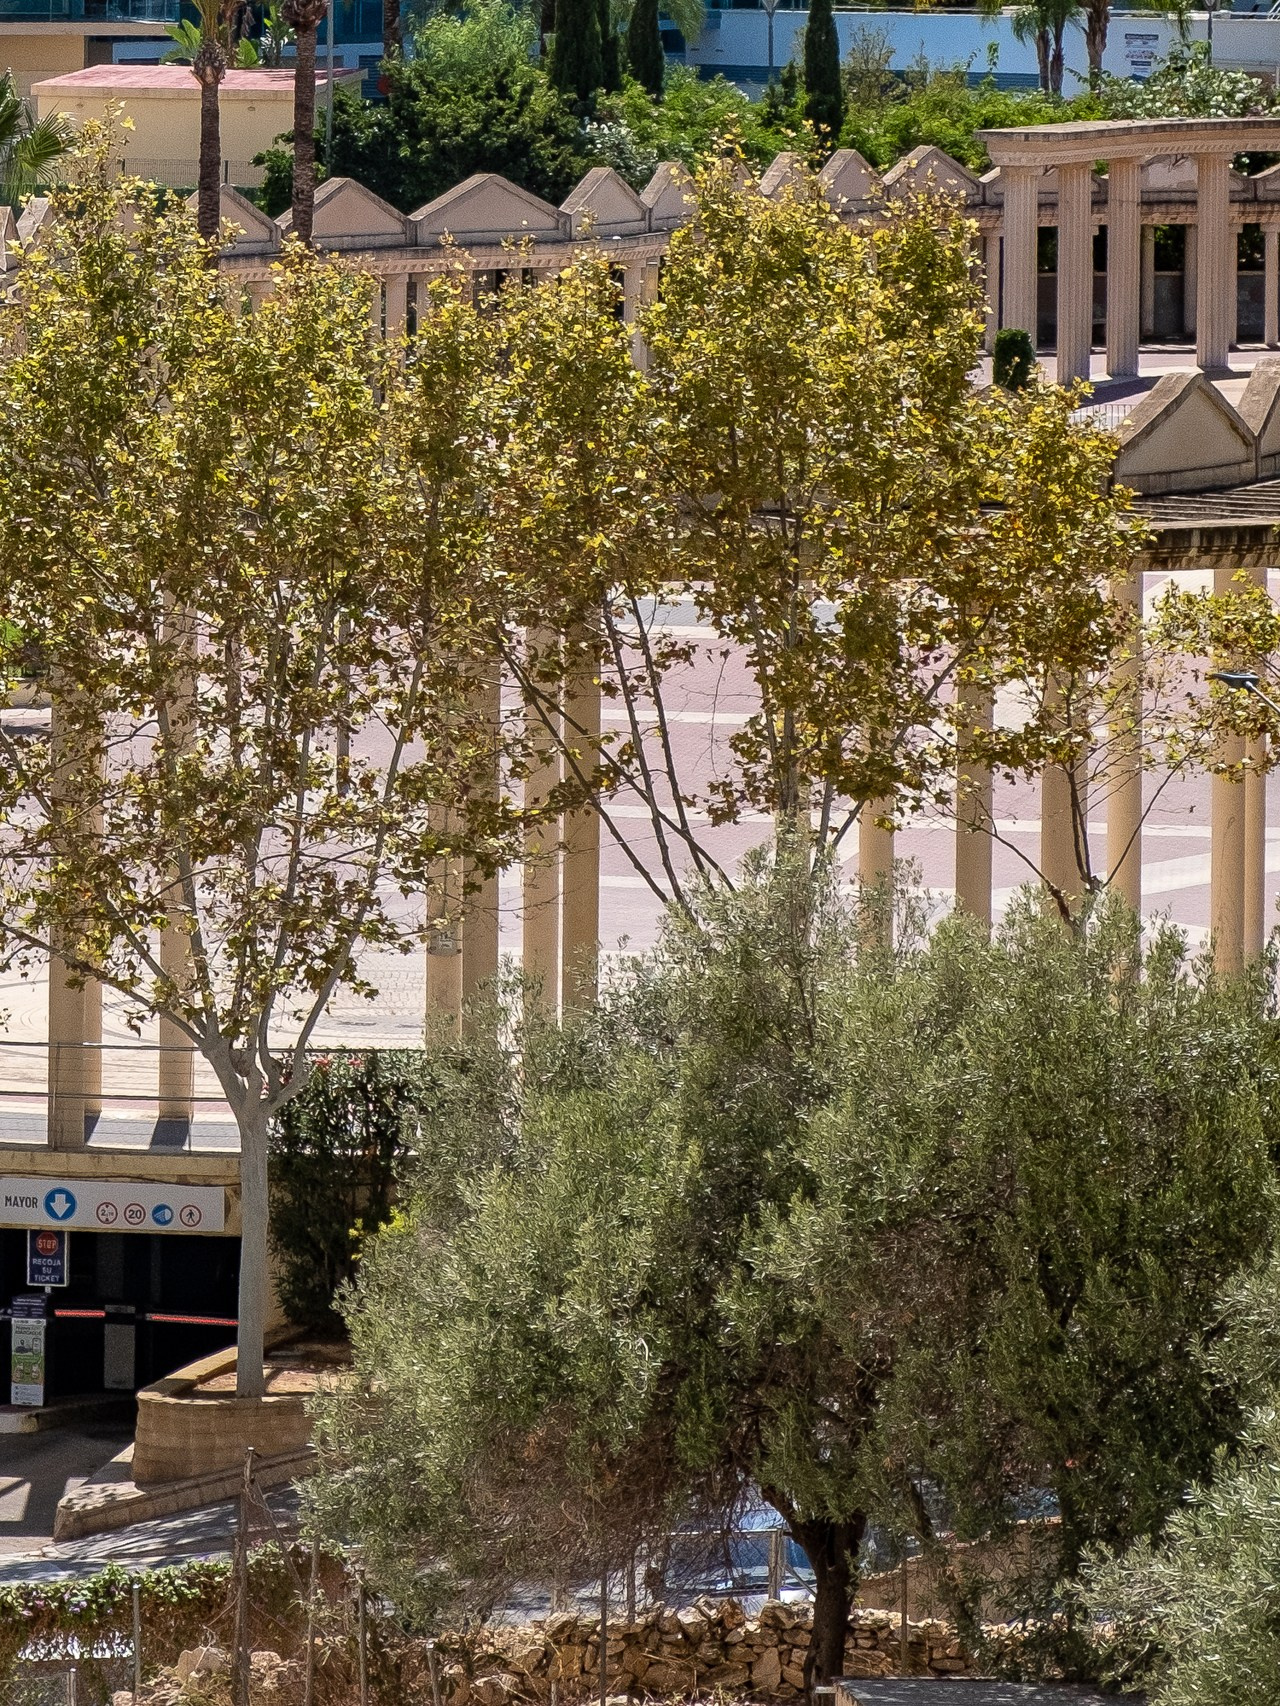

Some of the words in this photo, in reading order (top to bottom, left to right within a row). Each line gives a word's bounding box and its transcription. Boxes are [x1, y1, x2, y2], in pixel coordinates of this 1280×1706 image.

[5, 1195, 38, 1209] MAYOR
[128, 1209, 143, 1220] 20
[38, 1238, 57, 1249] STOP
[32, 1258, 61, 1266] RECOJA
[34, 1274, 60, 1283] TICKET
